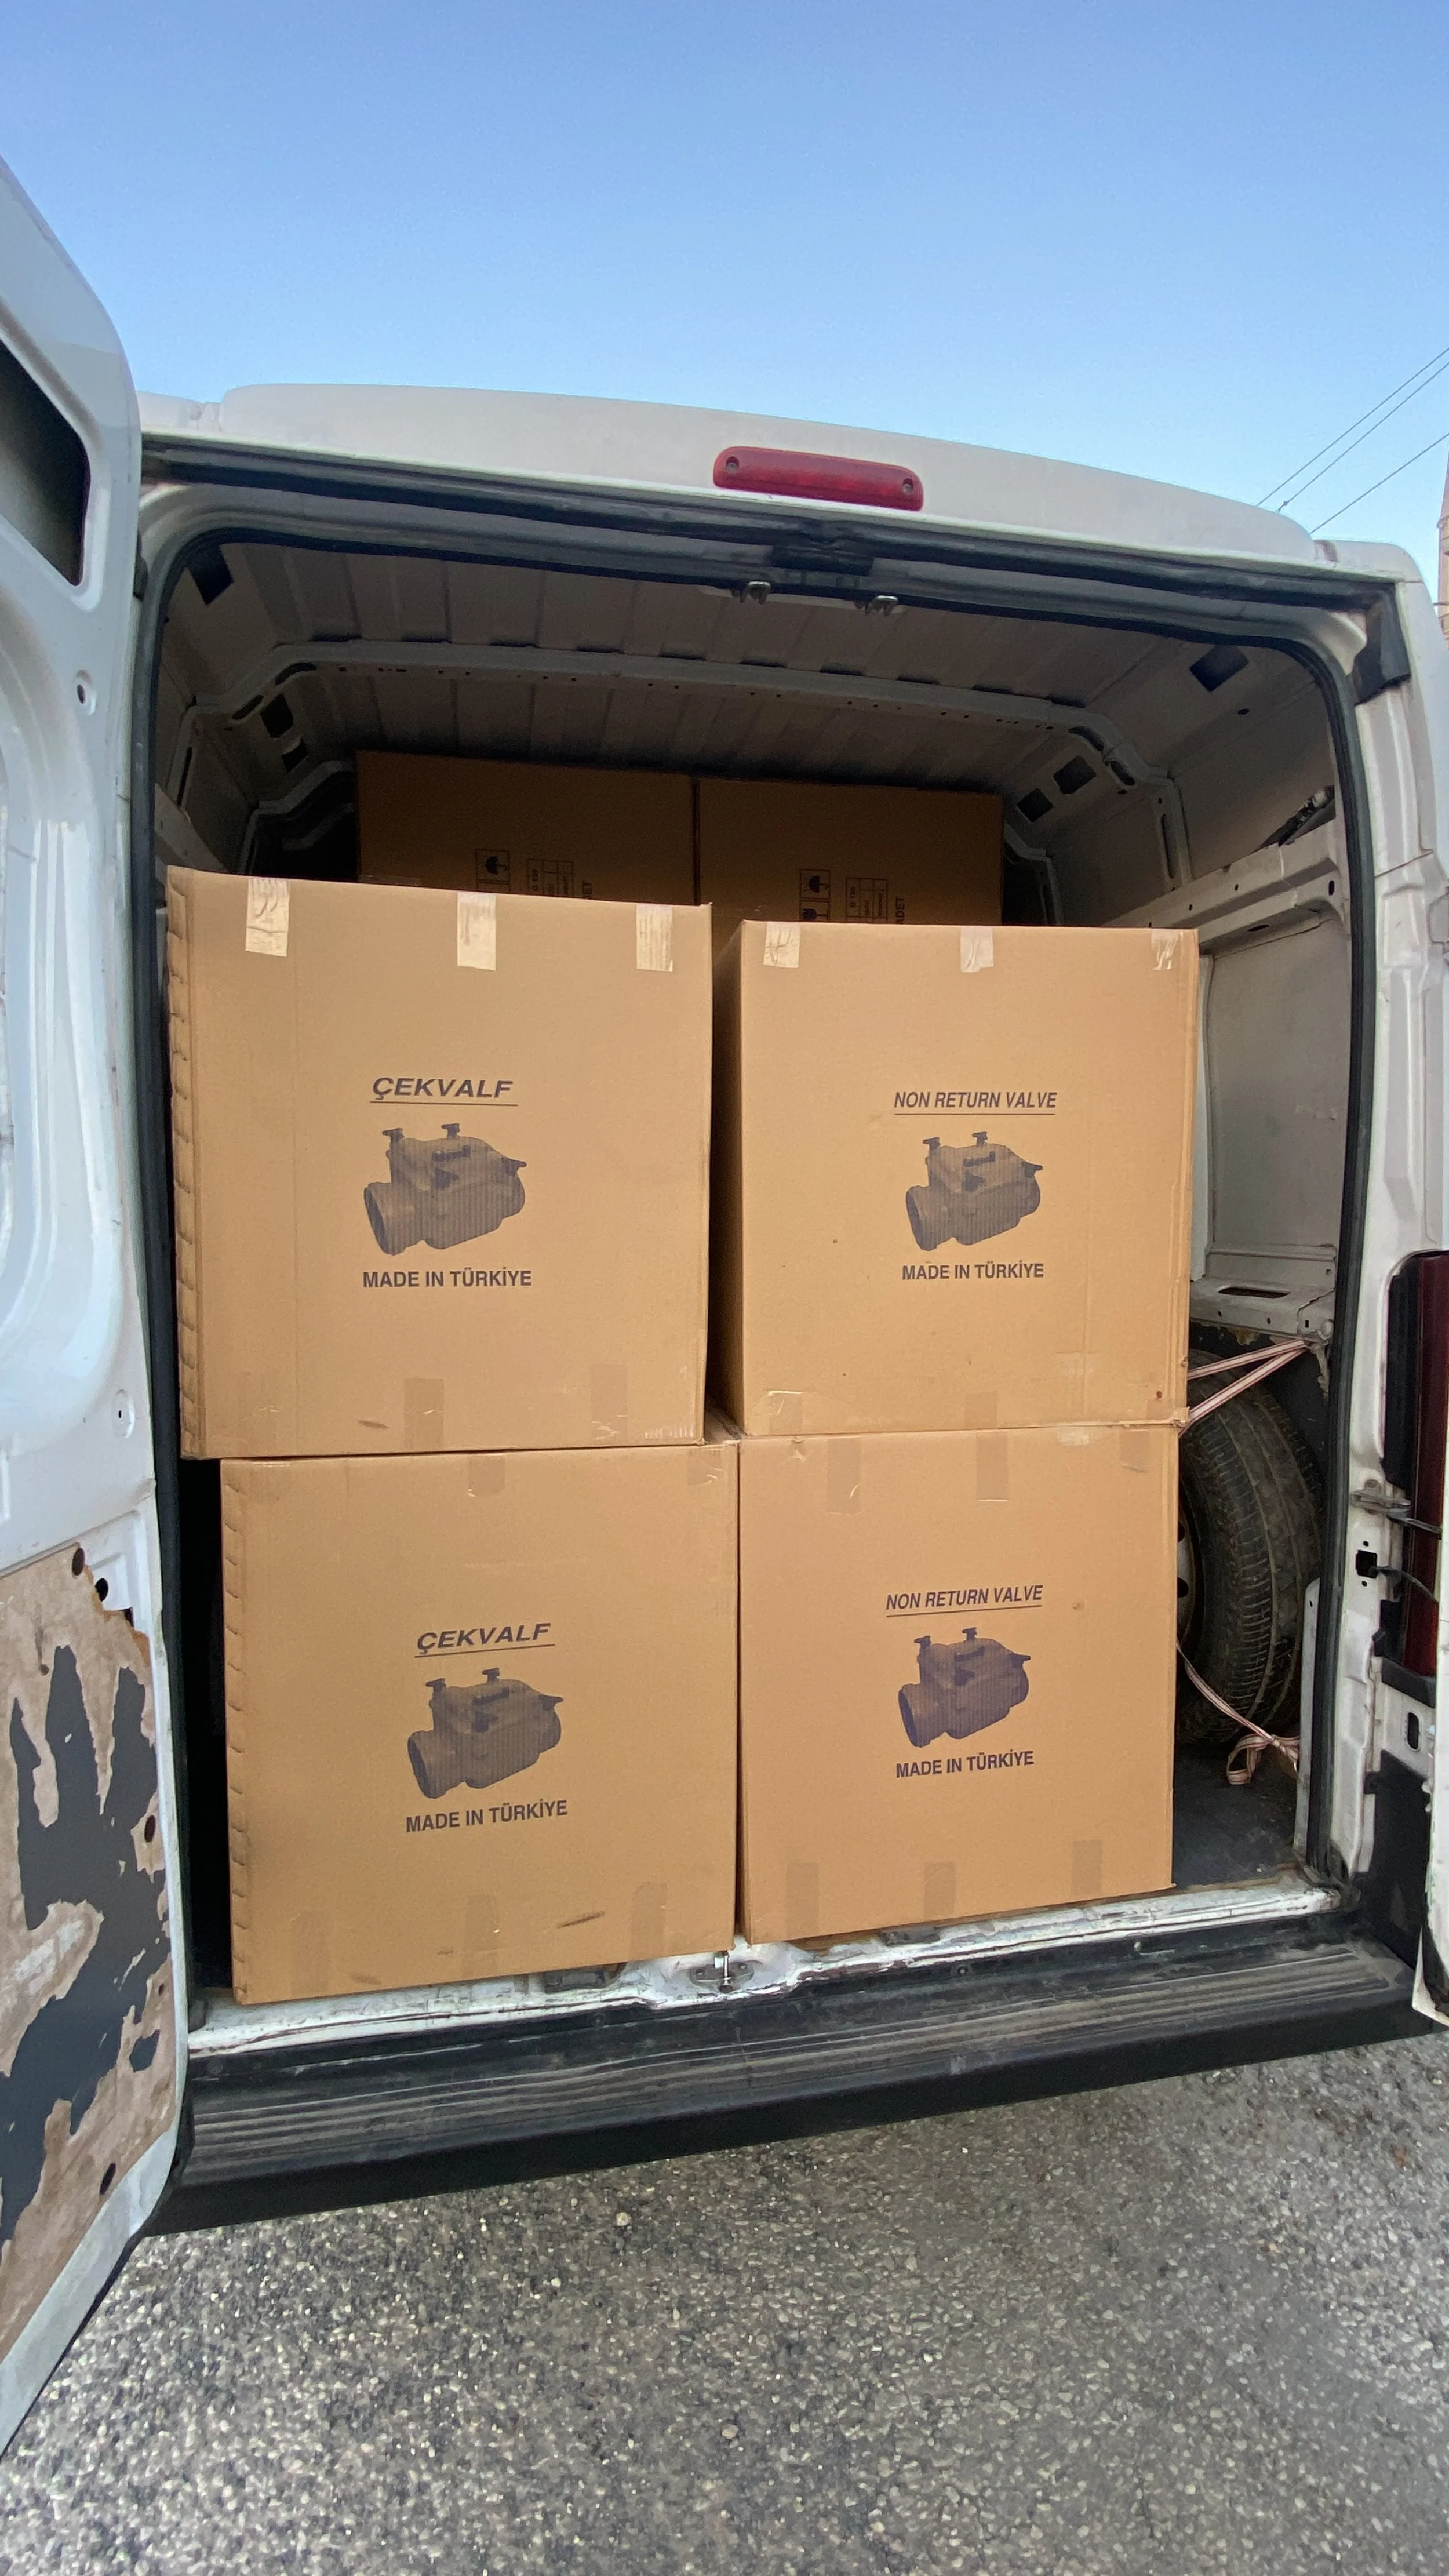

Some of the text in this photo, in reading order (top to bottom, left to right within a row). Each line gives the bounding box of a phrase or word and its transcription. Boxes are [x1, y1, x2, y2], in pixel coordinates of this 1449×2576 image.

[373, 1077, 514, 1100] ÇEKVALF
[894, 1091, 1058, 1108] NON RETURN VALVE
[363, 1266, 532, 1288] MADE IN TÜRKİYE
[902, 1260, 1044, 1280] MADE IN TÜRKİYE
[886, 1584, 1043, 1610] NON RETURN VALVE
[417, 1622, 551, 1654] ÇEKVALF
[896, 1749, 1035, 1778] MADE IN TÜRKİYE
[406, 1798, 568, 1833] MADE IN TÜRKİYE
